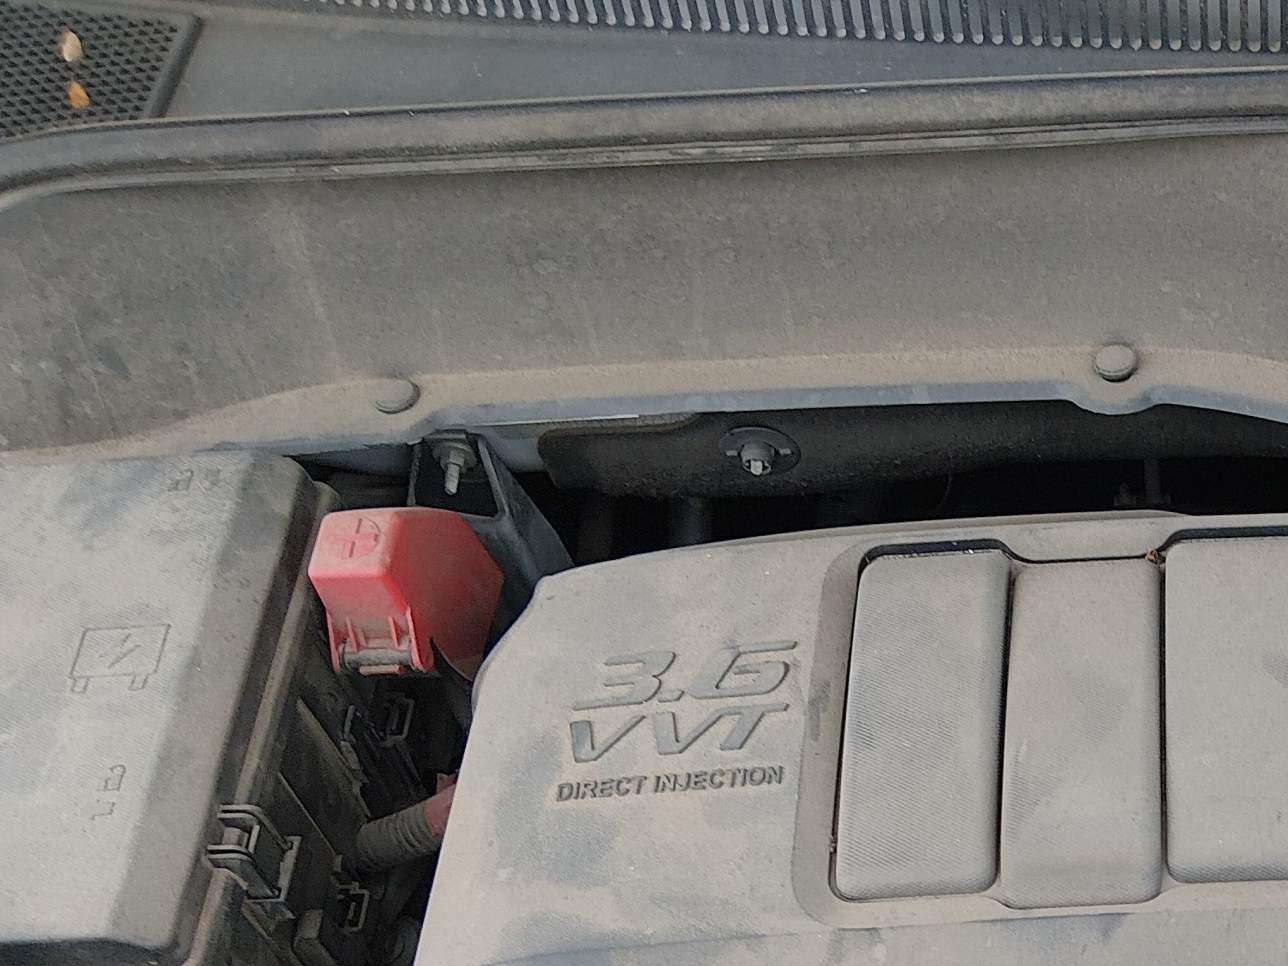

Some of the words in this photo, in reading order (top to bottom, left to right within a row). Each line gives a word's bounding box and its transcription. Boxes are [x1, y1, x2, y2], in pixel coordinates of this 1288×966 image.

[572, 640, 798, 712] 3.6
[569, 703, 790, 763] VVT
[556, 776, 648, 802] DIRECT
[653, 765, 785, 794] INJECTION
